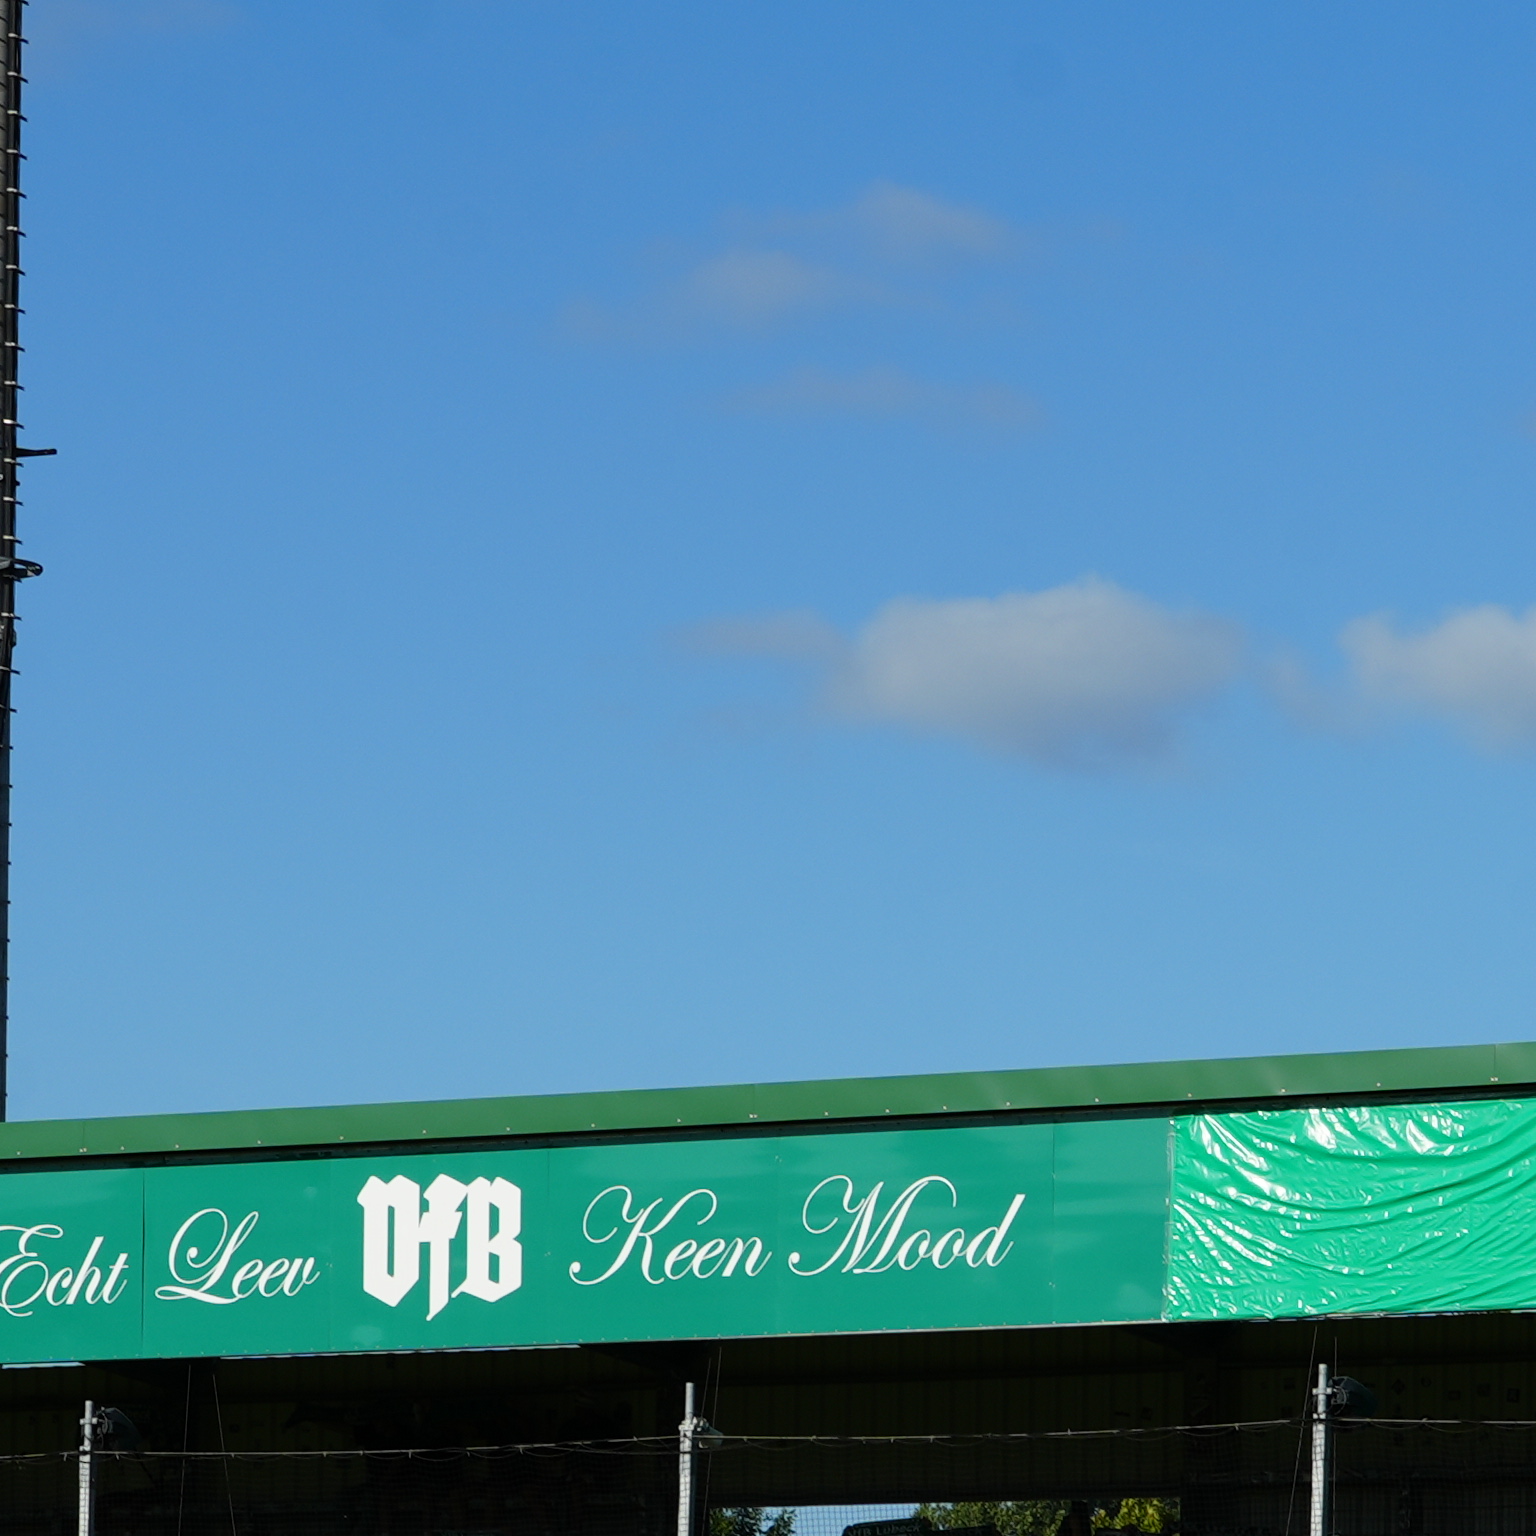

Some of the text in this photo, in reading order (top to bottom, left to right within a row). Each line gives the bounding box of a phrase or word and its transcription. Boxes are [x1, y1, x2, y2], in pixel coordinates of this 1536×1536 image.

[155, 1207, 320, 1305] Leev
[357, 1173, 523, 1322] VfB
[569, 1186, 773, 1289] Keen
[789, 1175, 1026, 1280] Mood
